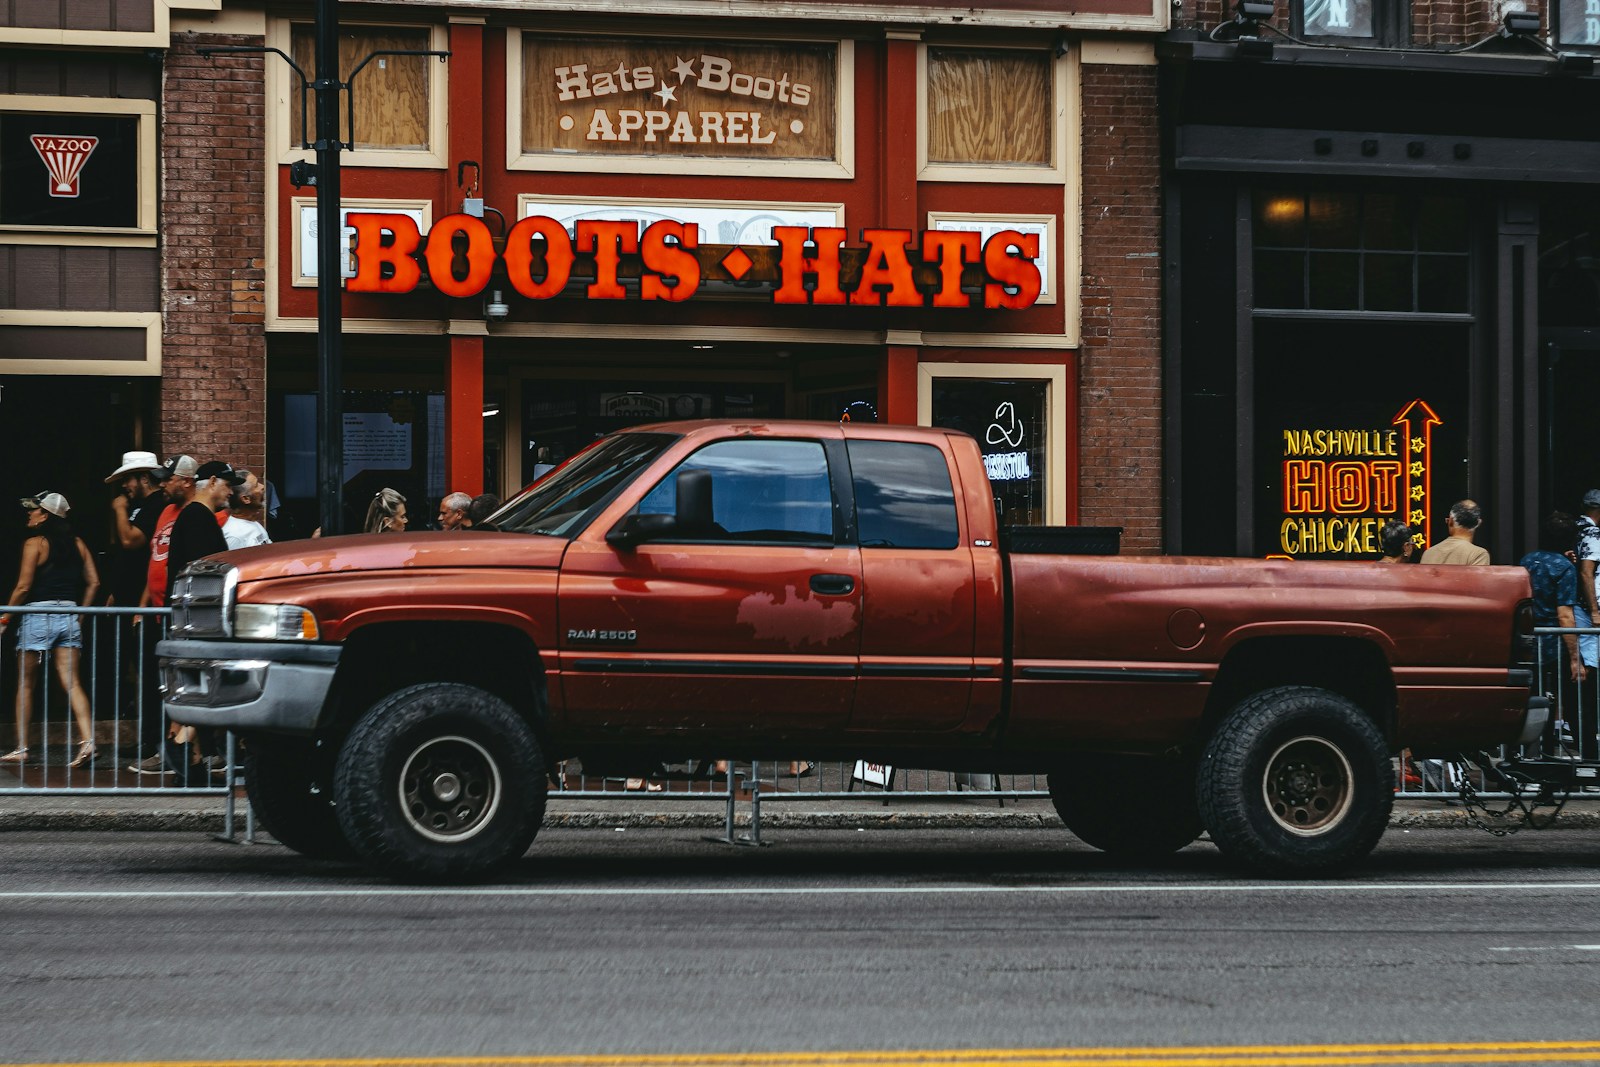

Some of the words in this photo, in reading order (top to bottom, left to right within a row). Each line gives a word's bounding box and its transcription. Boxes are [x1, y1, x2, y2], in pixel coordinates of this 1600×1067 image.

[554, 61, 655, 101] Hats
[696, 54, 812, 106] Boots
[586, 109, 777, 144] APPAREL
[37, 138, 92, 151] YAZOO
[345, 212, 700, 301] BOOTS
[773, 226, 1042, 310] HATS
[1283, 429, 1398, 457] NASHVILLE
[1283, 459, 1402, 514] HOT
[567, 629, 597, 639] RAM
[599, 629, 637, 640] 2500
